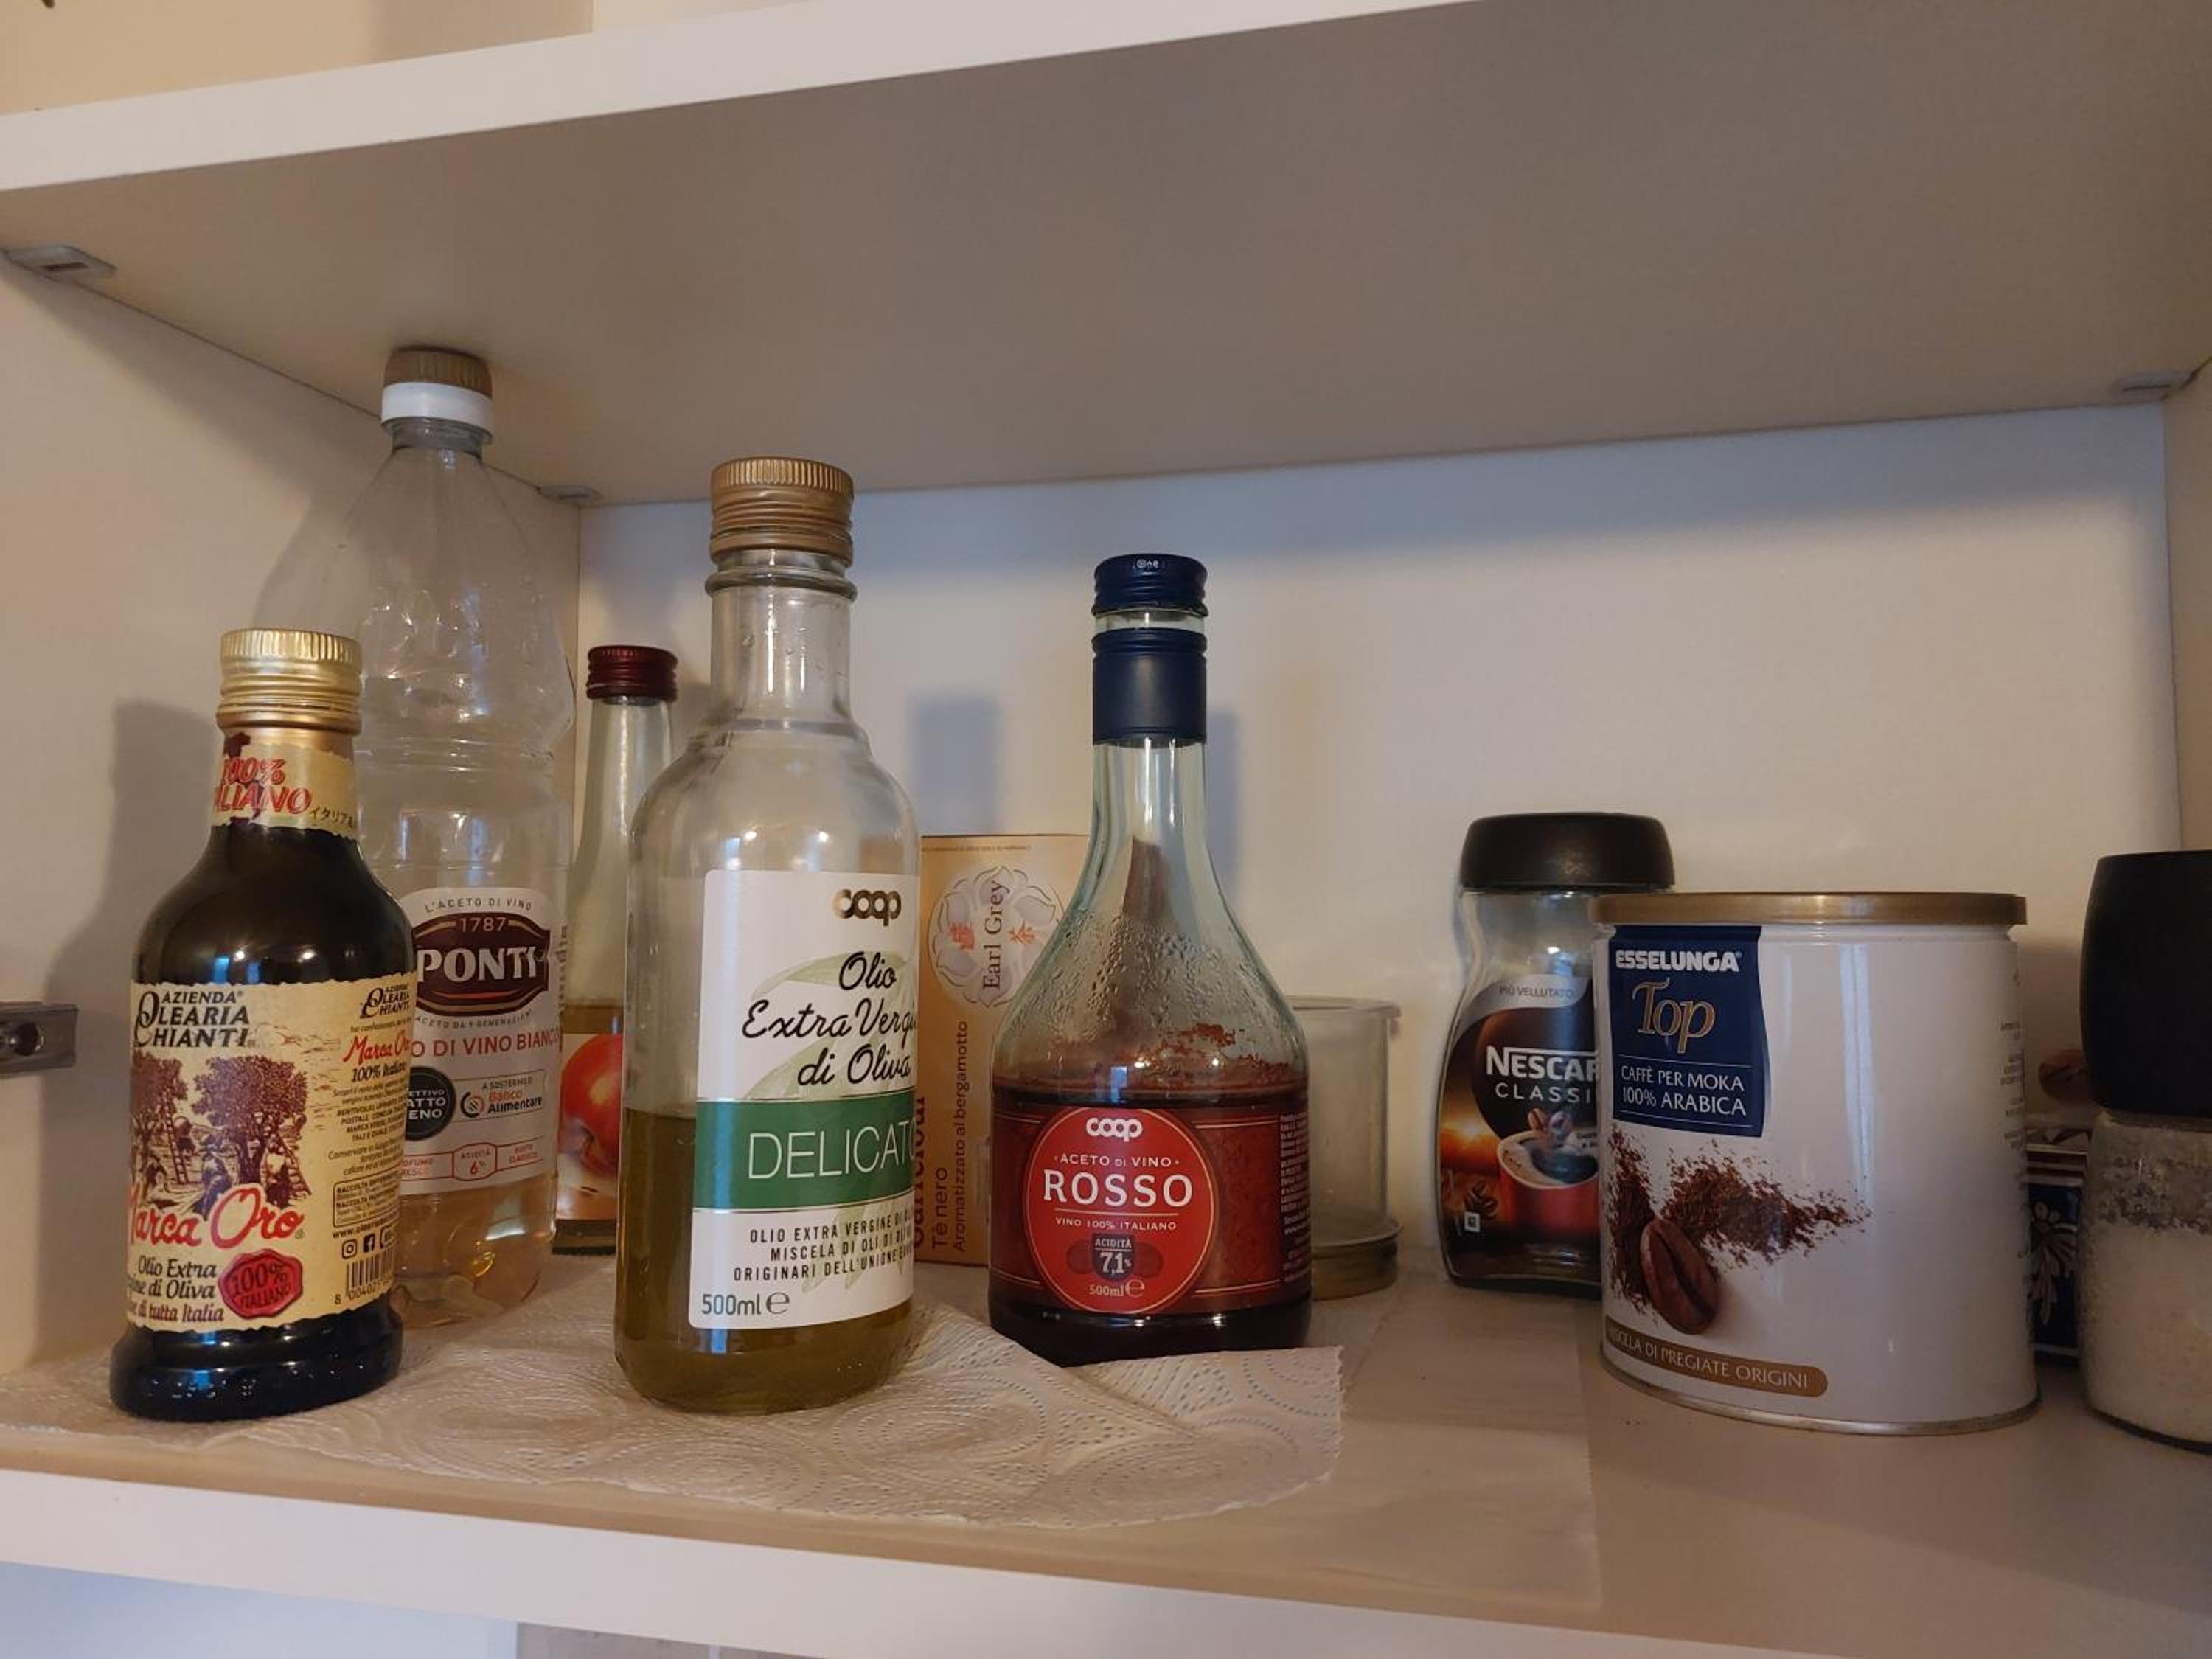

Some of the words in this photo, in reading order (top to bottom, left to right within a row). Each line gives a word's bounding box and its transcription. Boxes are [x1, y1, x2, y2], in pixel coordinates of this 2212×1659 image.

[216, 782, 313, 815] LIANO
[425, 897, 481, 913] L'ACETO
[489, 897, 501, 906] DI
[507, 897, 532, 911] VINO
[832, 889, 901, 927] coop
[984, 880, 1011, 934] Grey
[460, 917, 507, 932] 1787
[417, 946, 537, 982] PONTI
[839, 951, 897, 990] Olio
[982, 944, 1003, 990] Earl
[742, 999, 852, 1038] Extra
[1632, 978, 1716, 1053] Top
[434, 1037, 456, 1057] DI
[463, 1035, 512, 1055] VINO
[797, 1047, 835, 1086] di
[848, 1043, 911, 1084] Oliva
[953, 1020, 970, 1119] bergamotto
[1496, 1083, 1593, 1104] CLASSI
[1659, 1071, 1684, 1087] PER
[1688, 1074, 1745, 1092] MOKA
[488, 1096, 543, 1114] Alimentare
[1624, 1087, 1657, 1106] 100%
[1661, 1092, 1746, 1116] ARABICA
[953, 1122, 967, 1136] al
[1086, 1117, 1144, 1142] coop
[1060, 1154, 1110, 1166] ACETO
[1114, 1158, 1126, 1166] DI
[1132, 1157, 1172, 1167] VINO
[935, 1167, 948, 1217] nero
[953, 1141, 967, 1251] Aromatizzato
[1043, 1169, 1192, 1207] ROSSO
[211, 1187, 305, 1249] Oro
[750, 1229, 785, 1243] OLIO
[794, 1225, 838, 1241] EXTRA
[846, 1215, 891, 1236] VERGINE
[1056, 1217, 1082, 1227] VINO
[1087, 1220, 1115, 1231] 100%
[1120, 1221, 1177, 1231] ITALIANO
[771, 1242, 834, 1262] MISCELA
[842, 1242, 855, 1255] DI
[862, 1238, 878, 1253] OLI
[1095, 1237, 1132, 1248] ACIDITÀ
[138, 1255, 163, 1276] Olio
[167, 1259, 217, 1278] Extra
[734, 1264, 816, 1281] ORIGINARI
[148, 1279, 163, 1297] di
[166, 1279, 216, 1299] Oliva
[1089, 1284, 1124, 1297] 500ml
[182, 1303, 224, 1322] Italia
[701, 1293, 761, 1315] 500ml
[1645, 1343, 1658, 1361] DI
[1662, 1349, 1730, 1377] PREGIATE
[1736, 1365, 1808, 1389] ORIGINI
